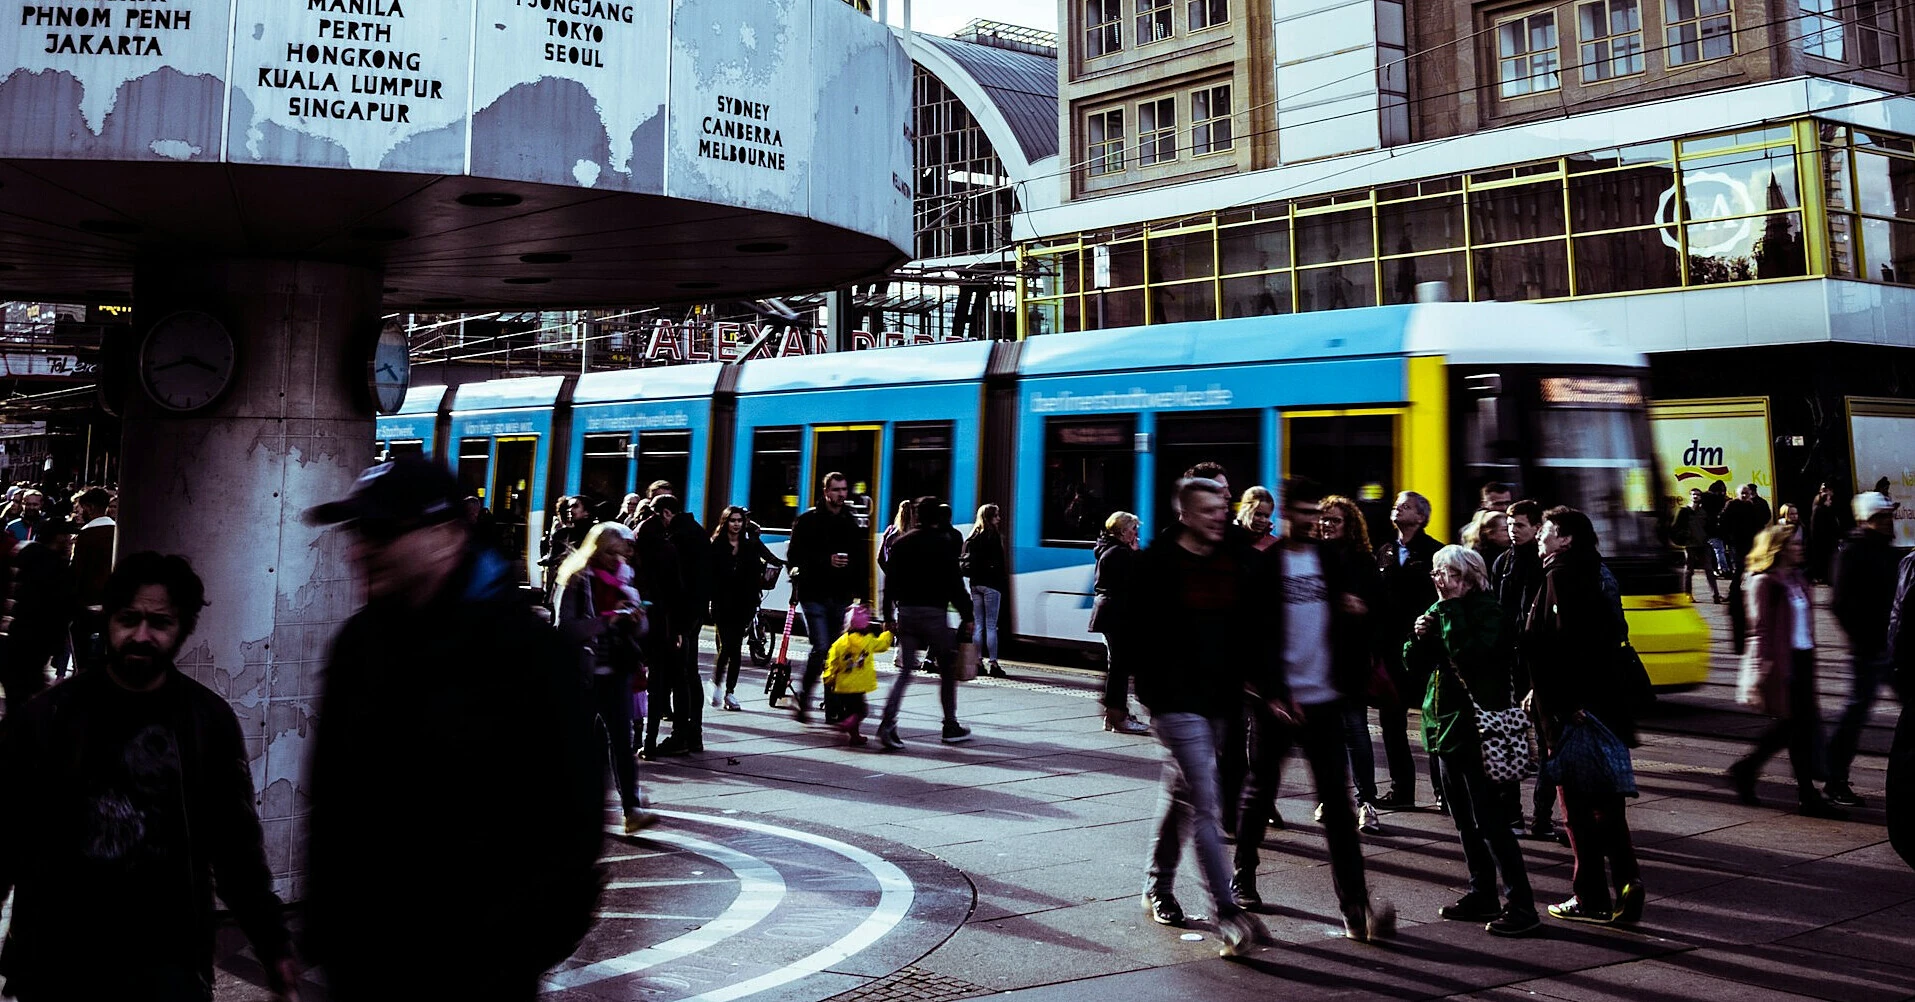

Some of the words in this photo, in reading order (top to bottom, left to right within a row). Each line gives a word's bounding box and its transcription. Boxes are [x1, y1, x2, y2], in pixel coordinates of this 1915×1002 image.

[22, 6, 110, 27] PHNOM
[126, 9, 191, 29] PENH
[308, 0, 404, 17] MANILA
[517, 0, 633, 23] ONGJANG
[319, 19, 391, 42] PERTH
[547, 18, 603, 42] TOKYO
[45, 34, 162, 56] JAKARTA
[287, 43, 420, 71] HONGKONG
[545, 43, 603, 67] SEOUL
[258, 68, 338, 91] KUALA
[352, 75, 442, 99] LUMPUR
[289, 97, 409, 123] SINGAPUR
[718, 96, 769, 121] SYDNEY
[703, 117, 782, 147] CANBERRA
[699, 139, 784, 170] MELBOURNE
[1683, 439, 1723, 466] dm
